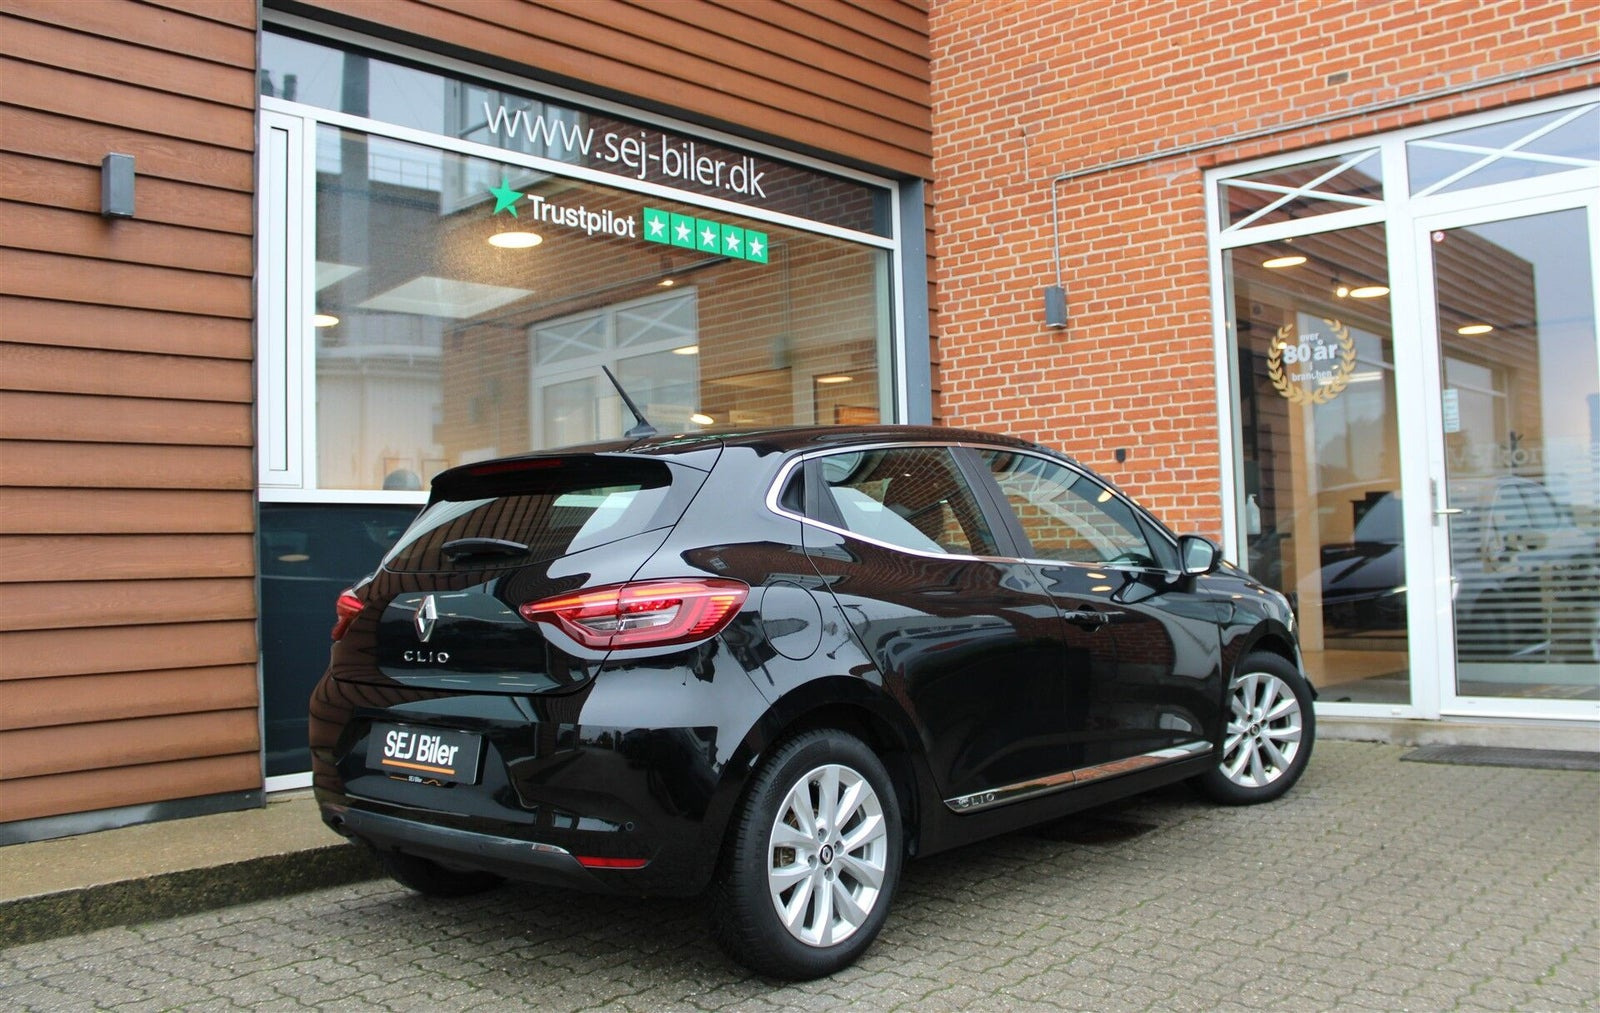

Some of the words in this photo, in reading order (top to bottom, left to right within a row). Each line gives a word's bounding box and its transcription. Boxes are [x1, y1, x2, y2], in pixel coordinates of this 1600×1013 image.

[484, 101, 767, 199] www.sej-biler.dk
[527, 194, 636, 238] Trustpilot
[1283, 343, 1311, 364] 80
[1313, 339, 1337, 360] år
[403, 650, 450, 664] CLIO
[384, 730, 417, 760] SEJ
[416, 734, 459, 766] Biler
[958, 793, 995, 808] CLIO
